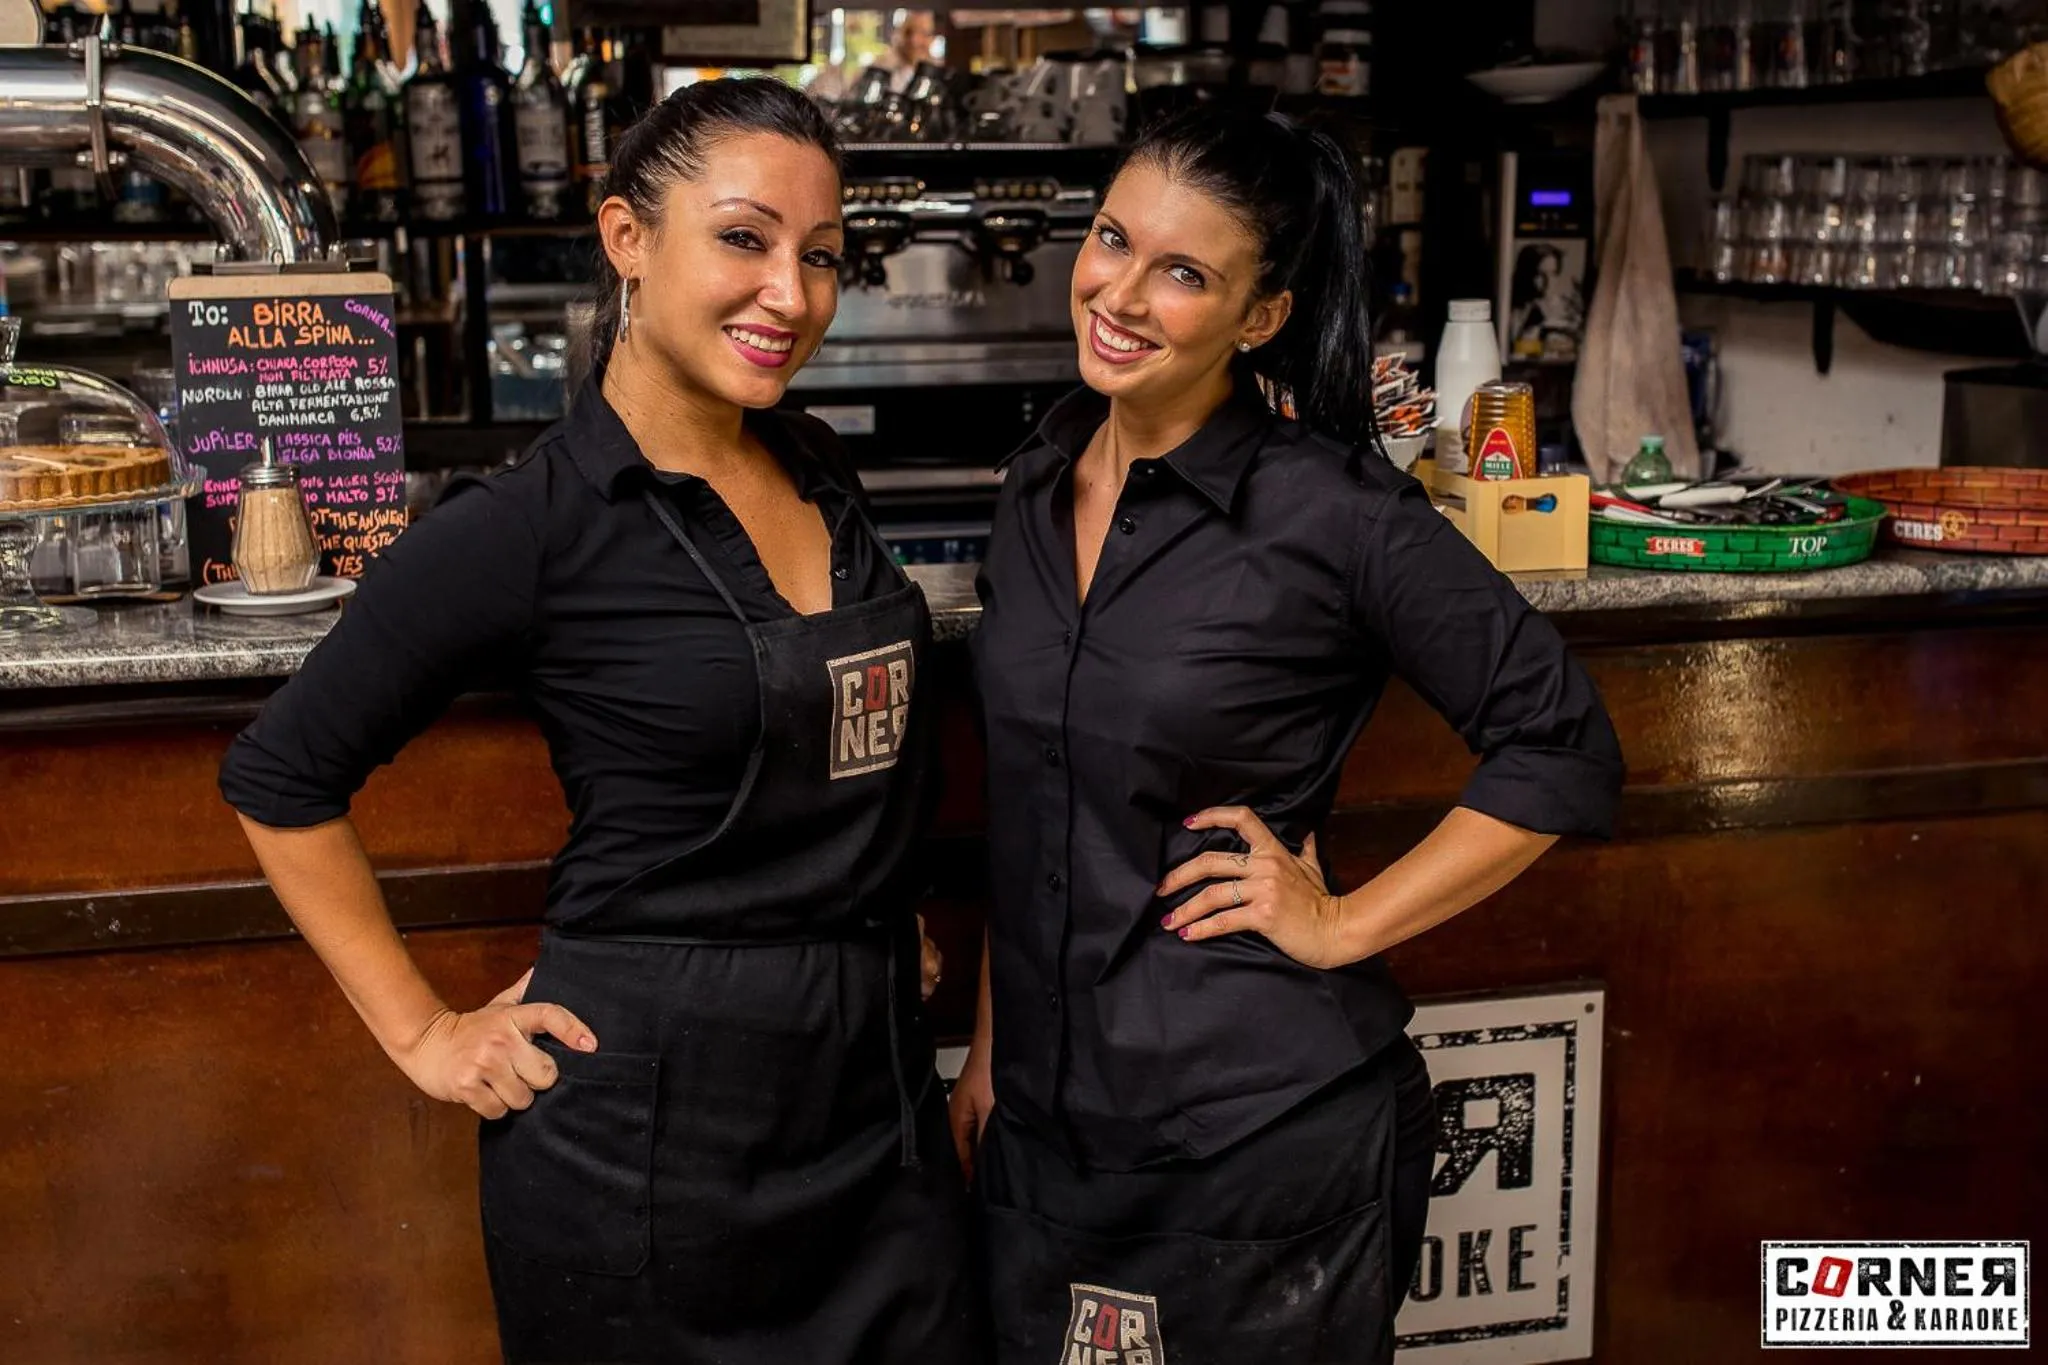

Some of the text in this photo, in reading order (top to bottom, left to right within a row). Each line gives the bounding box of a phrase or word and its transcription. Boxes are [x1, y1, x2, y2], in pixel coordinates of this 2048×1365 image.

[253, 299, 324, 328] BIRRA
[227, 325, 286, 349] ALLA
[367, 355, 388, 376] 5%
[259, 367, 351, 384] NON FILTRATA
[299, 382, 321, 395] OLD
[324, 379, 346, 393] ALE
[354, 377, 396, 392] ROSSA
[252, 399, 285, 413] ALTA
[258, 411, 336, 427] DANIMARCA
[188, 426, 258, 454] JUPILER
[276, 433, 332, 449] LASSICA
[328, 475, 369, 489] LAGER
[326, 489, 369, 504] MALTO
[1789, 536, 1828, 554] TOP
[332, 555, 364, 578] YES
[842, 659, 909, 718] COR
[1408, 1223, 1538, 1303] OKE
